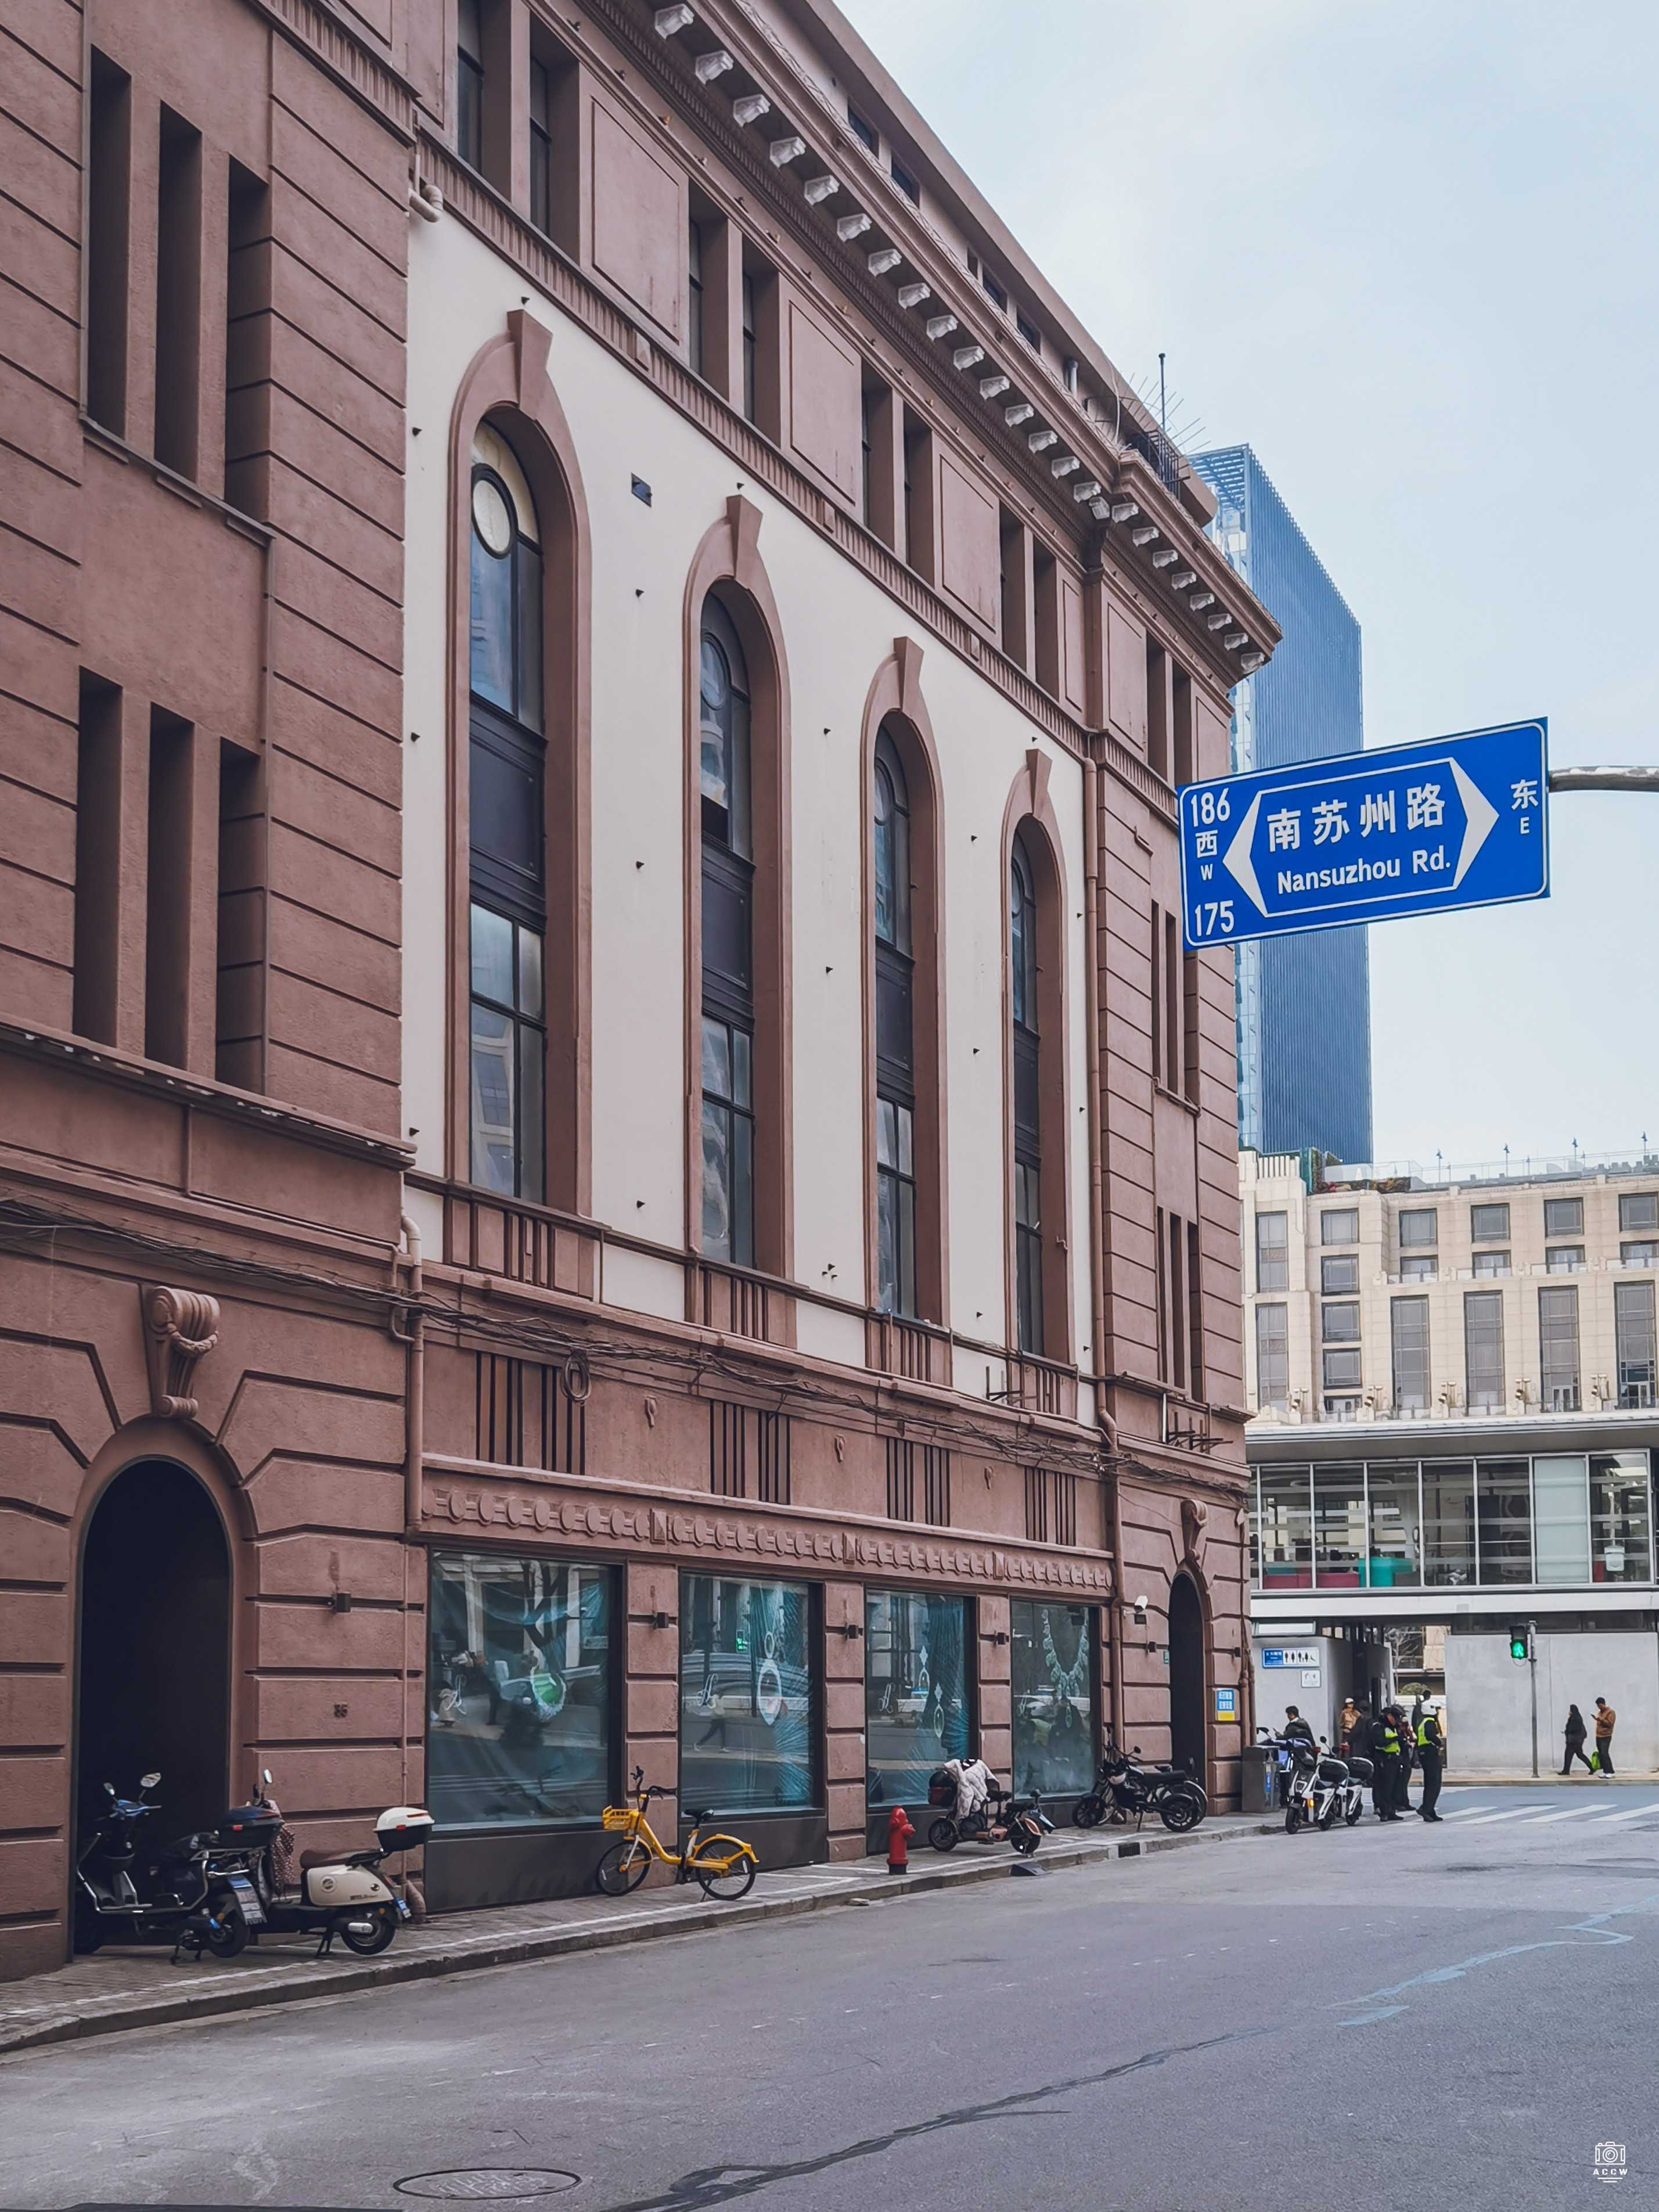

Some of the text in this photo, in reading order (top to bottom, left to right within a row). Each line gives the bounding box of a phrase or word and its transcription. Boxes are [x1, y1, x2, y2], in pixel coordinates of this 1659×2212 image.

[1191, 787, 1230, 828] 186
[1510, 779, 1538, 810] 东
[1267, 783, 1445, 852] 南苏州路
[1520, 817, 1530, 835] E
[1195, 829, 1218, 858] 西
[1200, 864, 1213, 880] W
[1277, 845, 1451, 894] Nansuzhou Rd.
[1195, 900, 1235, 937] 175
